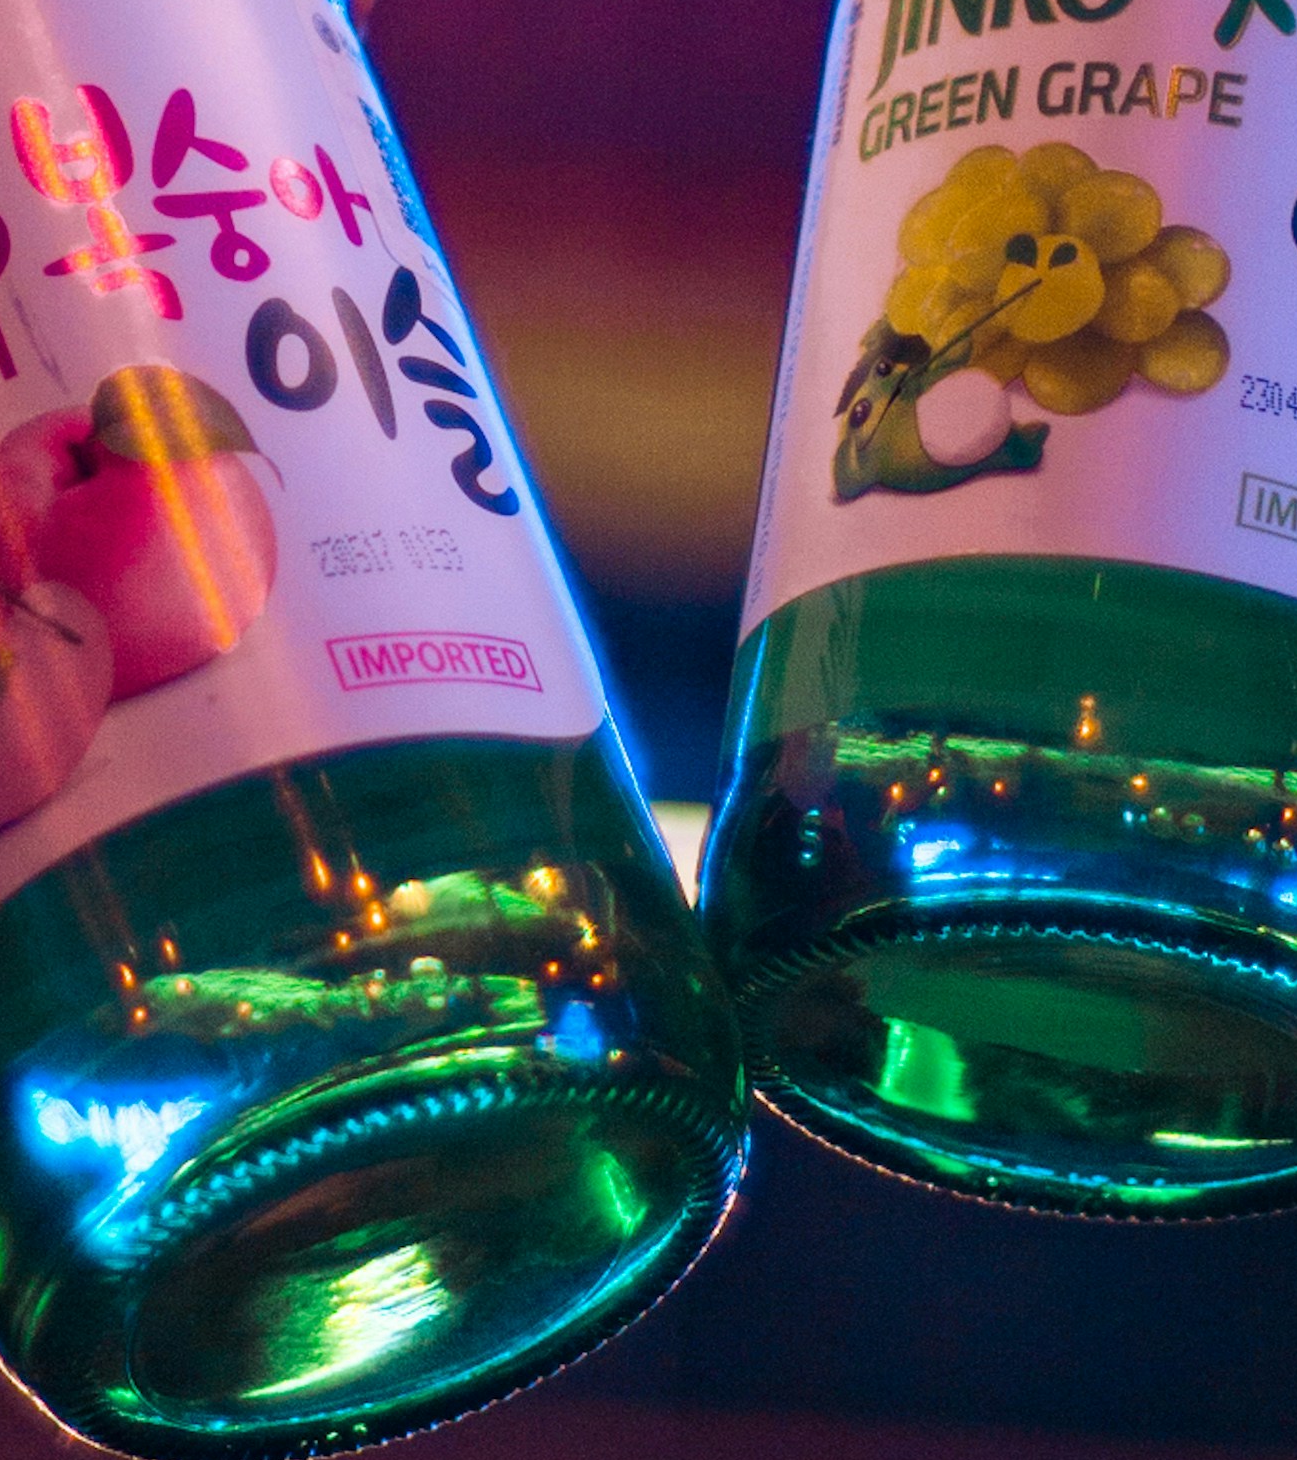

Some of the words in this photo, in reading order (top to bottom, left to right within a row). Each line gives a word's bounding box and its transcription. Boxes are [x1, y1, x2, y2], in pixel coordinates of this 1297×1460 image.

[859, 65, 1021, 163] GREEN
[1037, 60, 1248, 129] GRAPE
[10, 83, 373, 322] 복숭아
[244, 264, 521, 517] 이슬
[345, 640, 528, 680] IMPORTED
